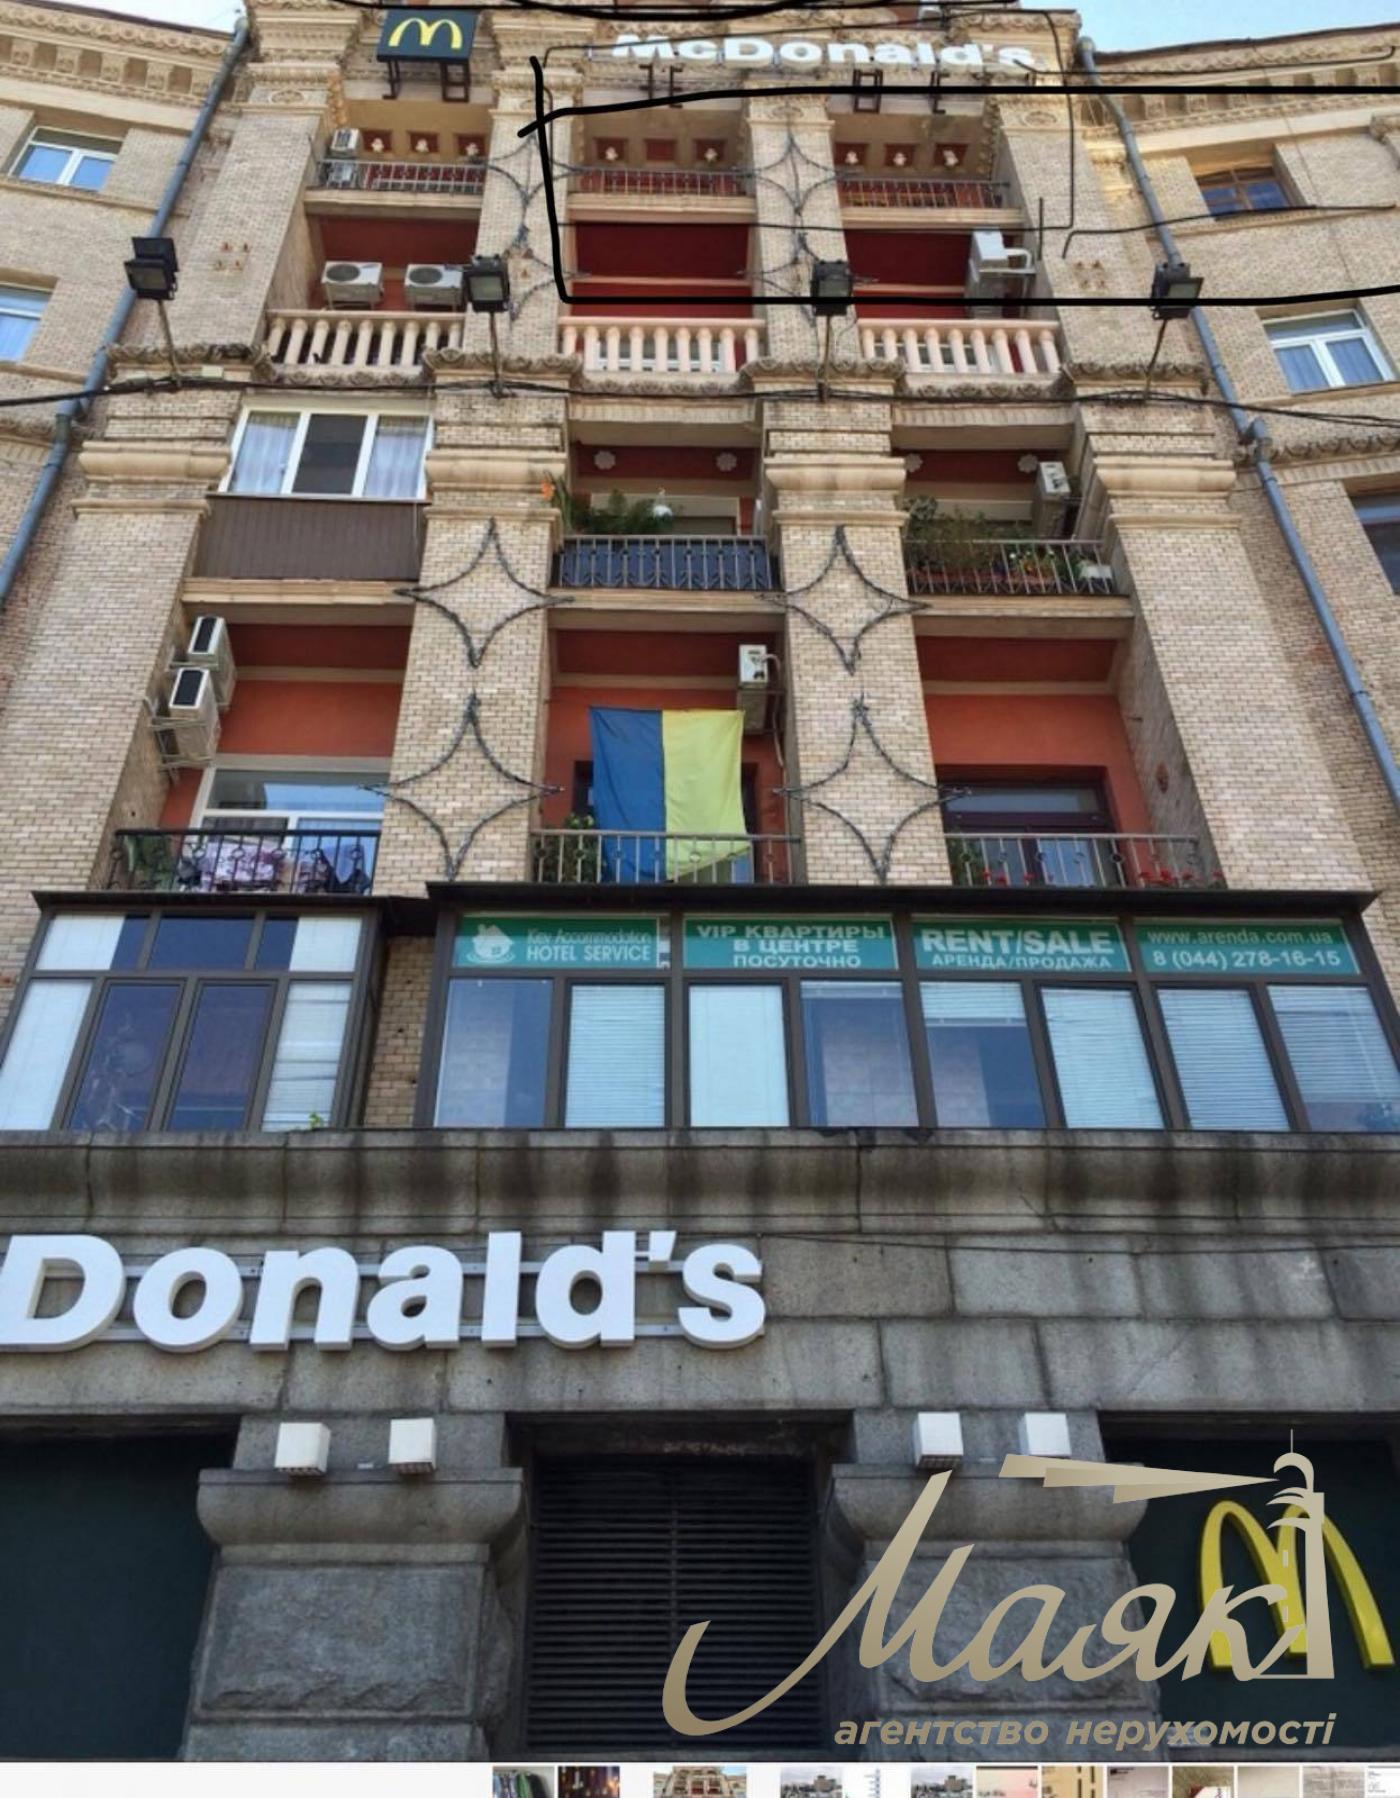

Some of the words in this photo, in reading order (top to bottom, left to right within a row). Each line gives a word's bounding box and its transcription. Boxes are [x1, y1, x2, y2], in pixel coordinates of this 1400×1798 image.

[611, 33, 1036, 72] McDonald's
[697, 925, 737, 939] VIP
[745, 925, 886, 940] КВАРТИРЫ
[1147, 928, 1333, 945] www.arenda.com.ua
[733, 939, 751, 953] В
[758, 939, 860, 955] ЦЕНТРЕ
[920, 928, 1116, 955] RENT/SALE
[527, 945, 577, 961] HOTEL
[583, 945, 652, 962] SERVICE
[733, 955, 862, 969] ПОСУТОЧНО
[931, 954, 1113, 969] АРЕНДА/ПРОДАЖА
[1153, 950, 1168, 966] 8
[1172, 950, 1228, 971] (044)
[1232, 950, 1341, 968] 278-16-15
[0, 1231, 766, 1352] Donald's
